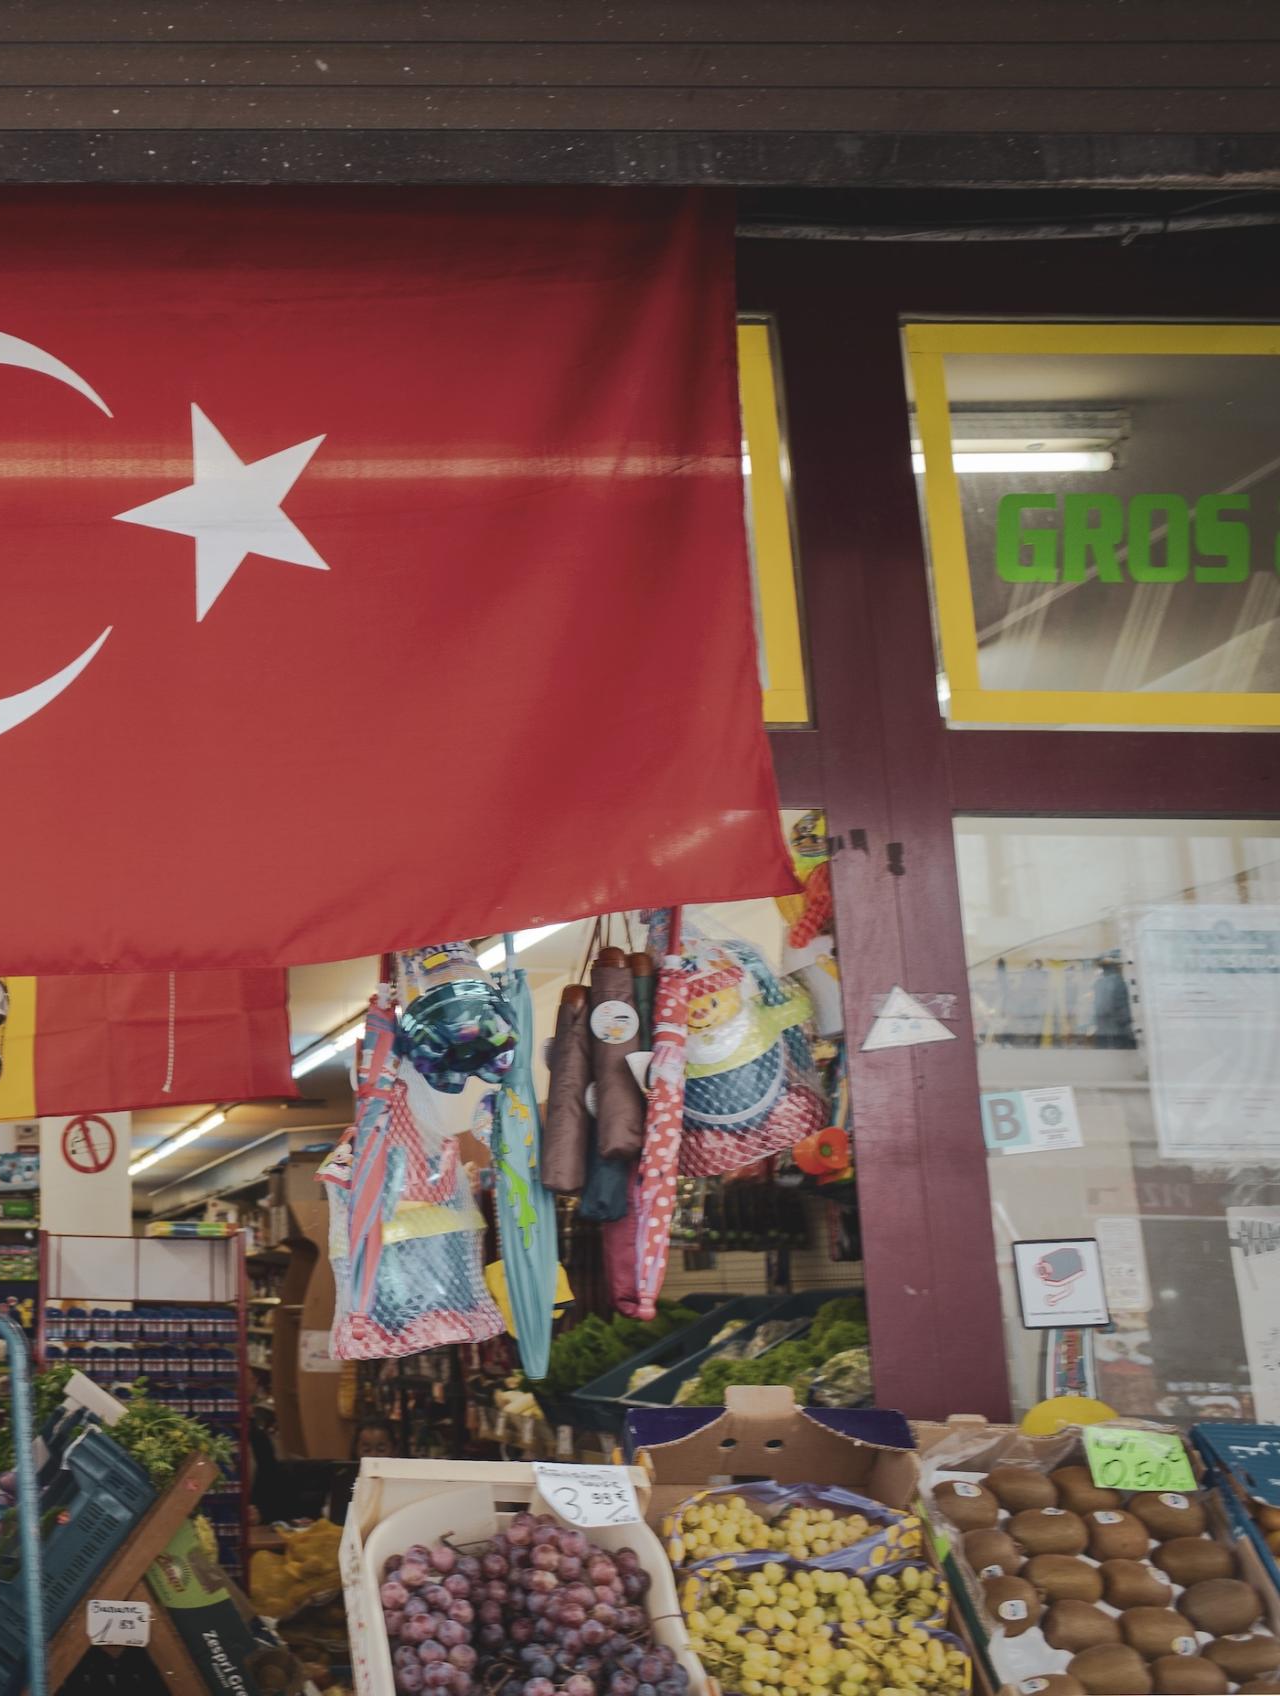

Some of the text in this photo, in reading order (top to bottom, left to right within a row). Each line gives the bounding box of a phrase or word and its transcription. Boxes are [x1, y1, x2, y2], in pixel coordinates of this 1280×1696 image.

[996, 493, 1251, 584] GROS
[988, 1098, 1022, 1141] B
[201, 1628, 237, 1674] Zespri
